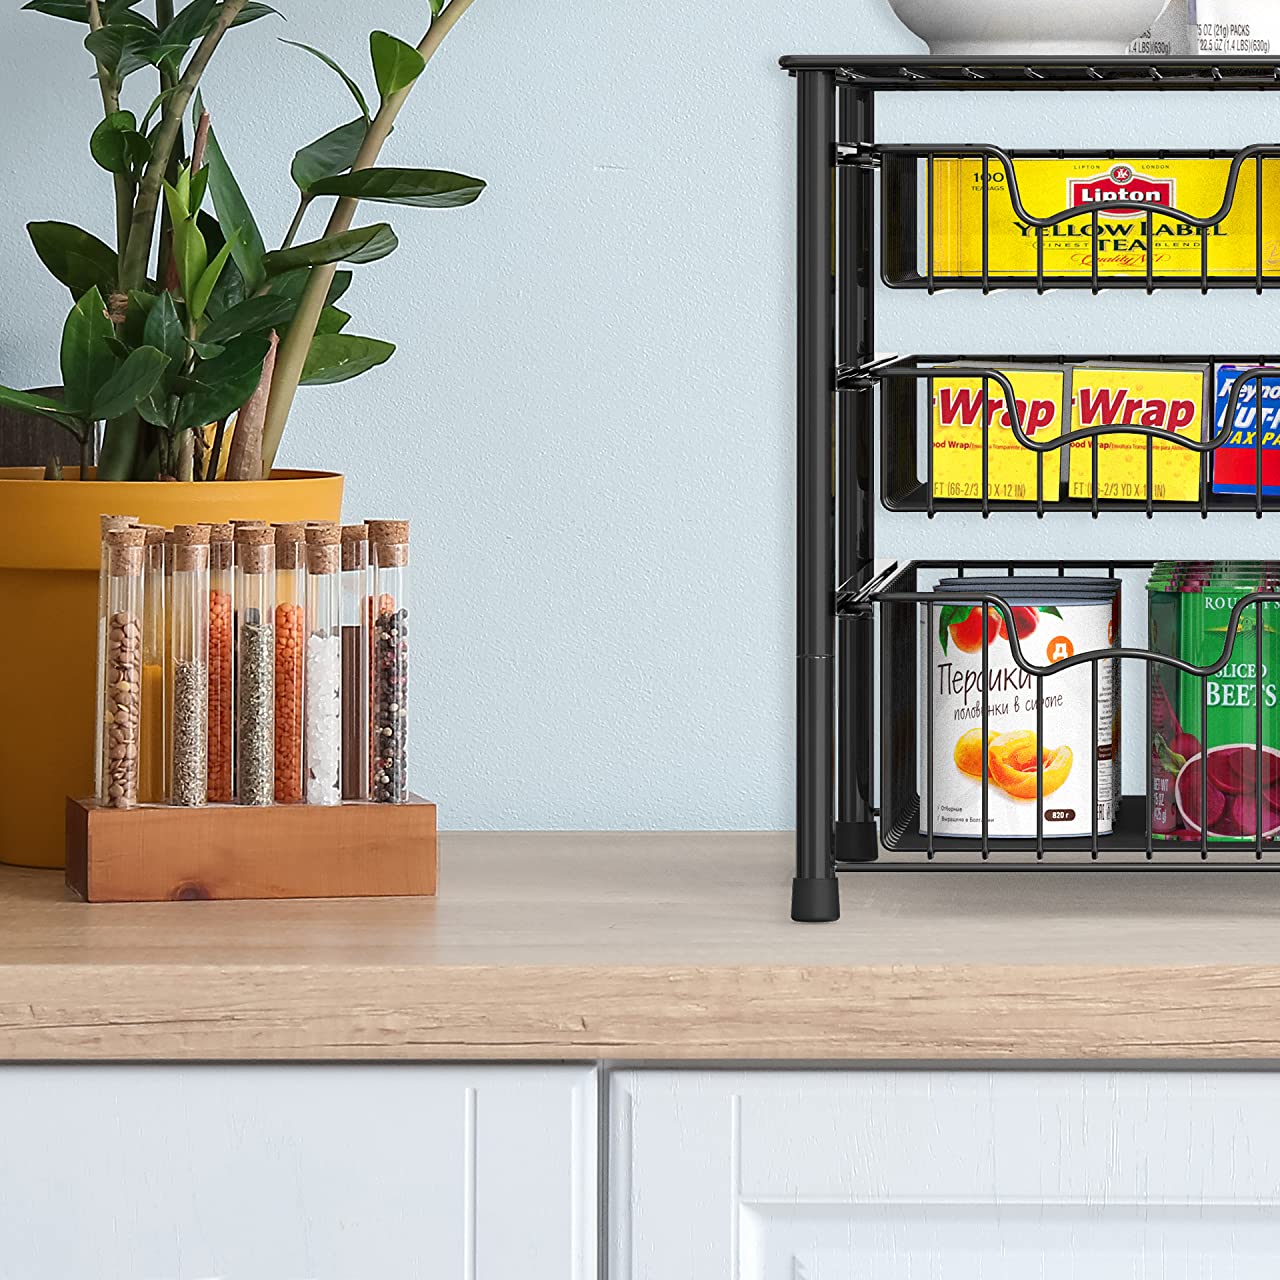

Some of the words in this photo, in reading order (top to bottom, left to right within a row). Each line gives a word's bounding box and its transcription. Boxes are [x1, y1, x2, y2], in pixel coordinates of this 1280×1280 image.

[1213, 23, 1229, 39] (21g)
[1230, 24, 1250, 36] PACKS
[974, 172, 1004, 183] 100
[1081, 187, 1162, 203] Lipton
[1013, 221, 1134, 237] YELLOW
[1140, 221, 1228, 236] LABEL
[1098, 239, 1148, 252] TEA
[940, 388, 1056, 436] Wrap
[1080, 388, 1196, 433] Wrap
[933, 440, 946, 449] ood
[1070, 440, 1085, 449] ood
[934, 482, 944, 495] FT
[947, 482, 979, 497] (66-2/3
[994, 483, 1000, 496] X
[1004, 483, 1013, 496] 12
[1073, 482, 1085, 495] FT
[1087, 482, 1119, 497] (-2/3
[1134, 483, 1141, 496] X
[1205, 596, 1280, 610] ROUYS
[1215, 663, 1268, 679] SLICED
[937, 662, 1032, 706] Персики
[1206, 681, 1278, 707] BEETS
[953, 701, 1009, 721] половнки
[1013, 695, 1021, 713] в
[1025, 694, 1064, 712] сиопе
[1052, 811, 1065, 819] 820
